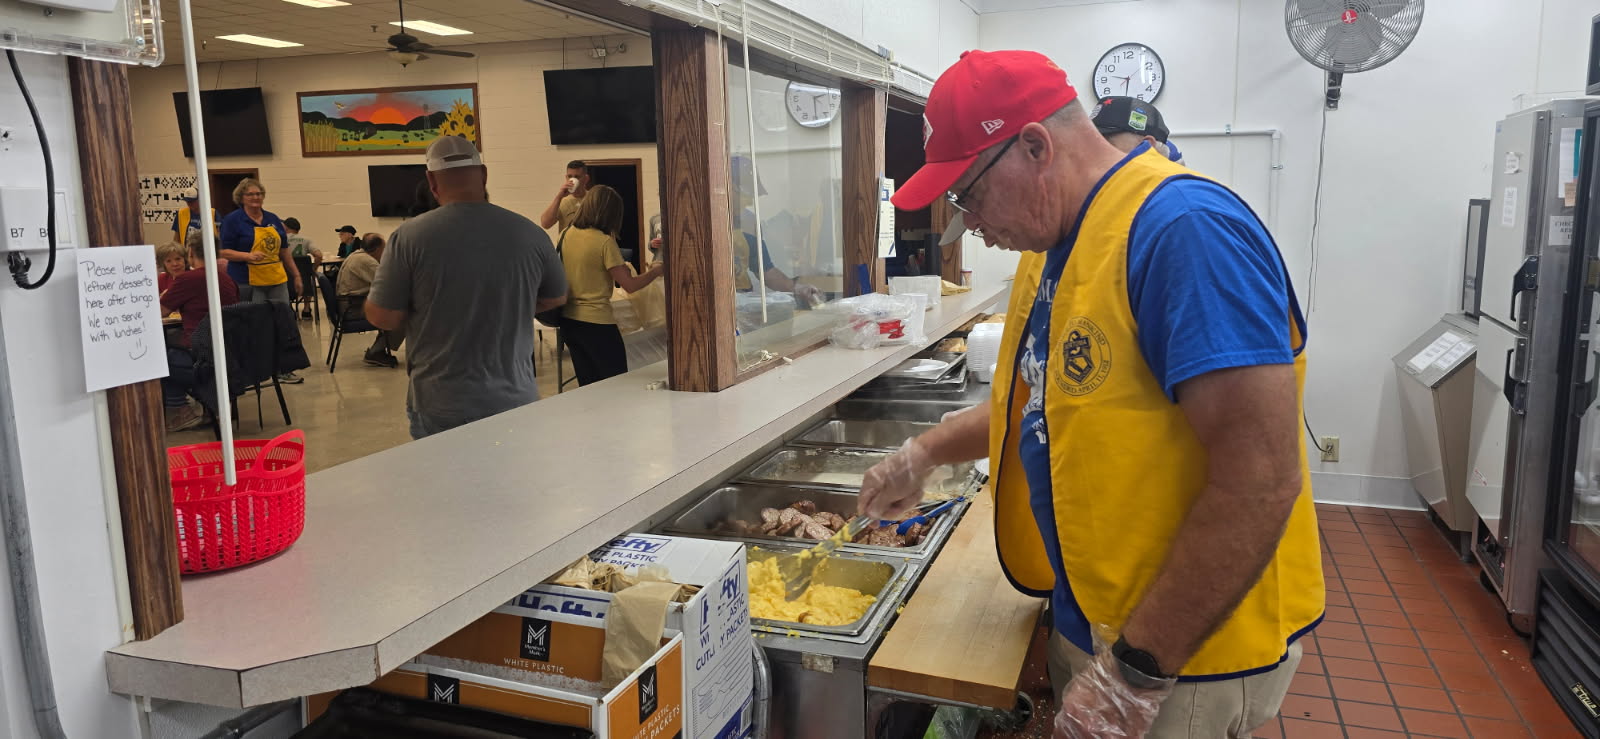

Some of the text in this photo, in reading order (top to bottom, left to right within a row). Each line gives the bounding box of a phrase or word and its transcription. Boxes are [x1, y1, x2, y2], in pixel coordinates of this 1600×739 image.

[1123, 51, 1134, 59] 12
[1145, 62, 1153, 70] 2
[1104, 87, 1110, 95] 8
[11, 228, 24, 238] B7
[40, 228, 49, 238] B
[80, 259, 144, 278] Please leave
[84, 275, 153, 293] leftover desserts
[85, 292, 153, 309] here after bingo
[88, 312, 143, 328] We can serve
[90, 330, 110, 343] with
[609, 538, 661, 552] efty
[612, 551, 658, 562] PLASTIC
[726, 607, 748, 640] PACKETS
[503, 658, 565, 674] WHITE PLASTIC
[651, 704, 680, 739] PACKETS
